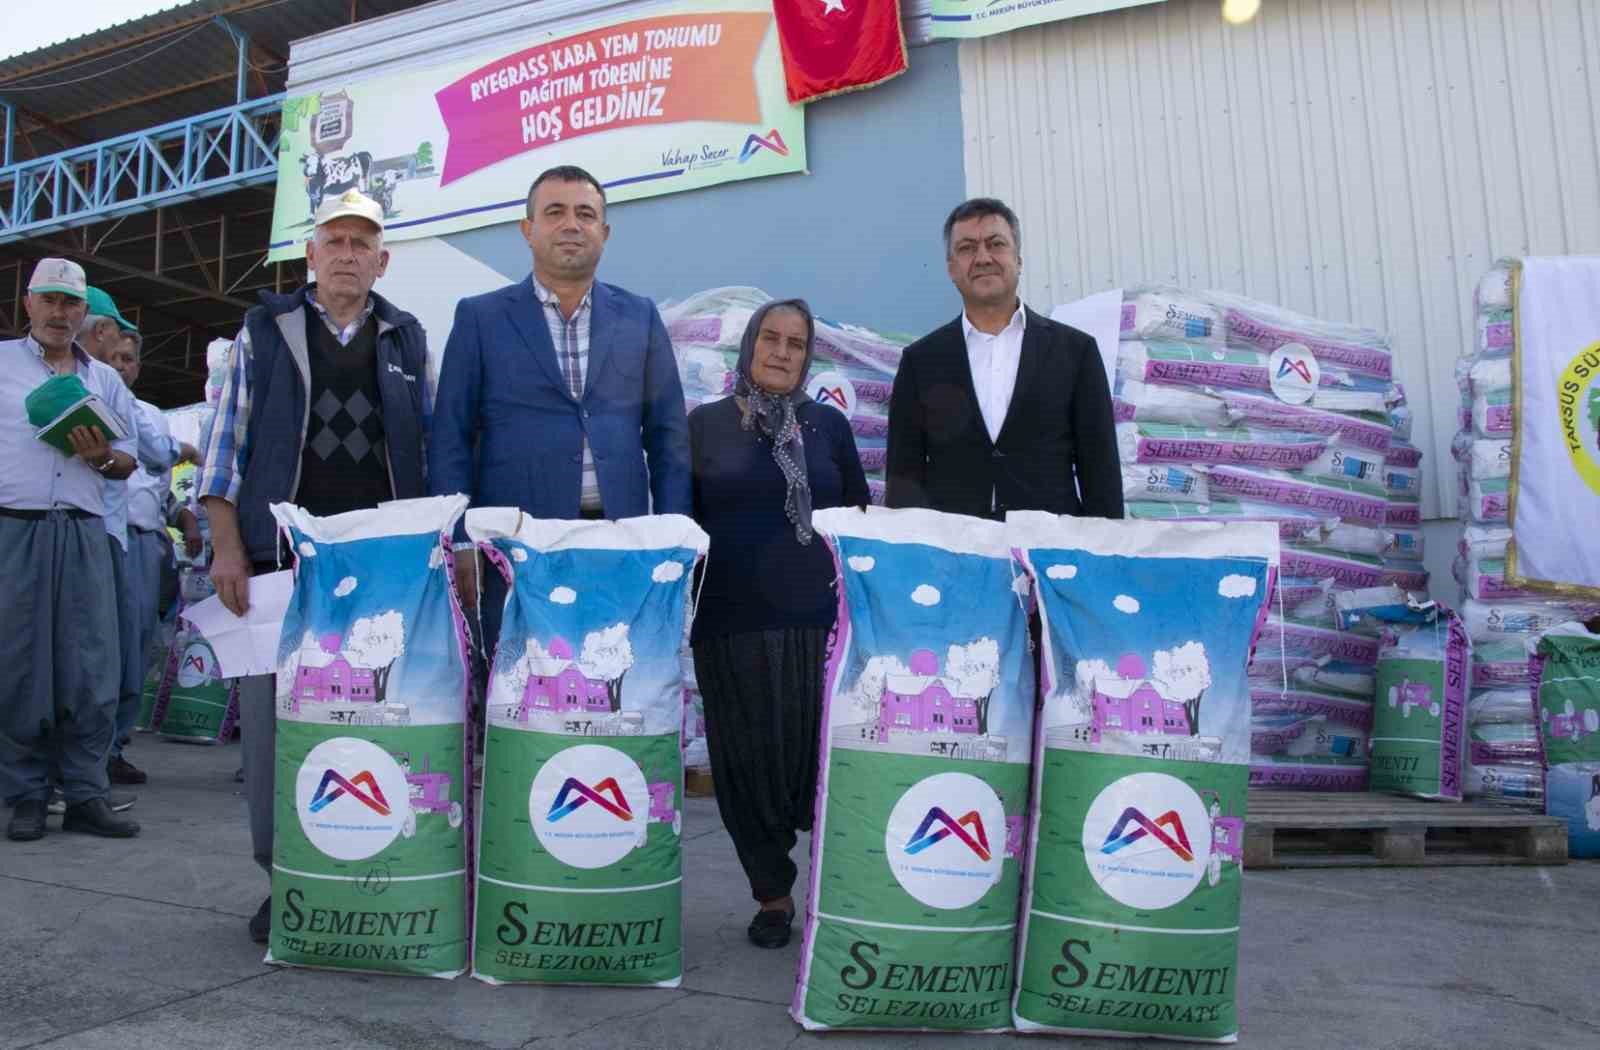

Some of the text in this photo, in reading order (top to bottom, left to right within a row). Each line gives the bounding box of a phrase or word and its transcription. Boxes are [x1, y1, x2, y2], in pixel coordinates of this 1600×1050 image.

[470, 23, 722, 102] RYEGRASS KABA YEM TOHUMU
[519, 56, 673, 110] DAĞITIM TÖRENİ'NE
[520, 82, 666, 144] HOŞ GELDİNİZ
[661, 148, 698, 171] Vahap
[1559, 346, 1600, 454] TARSUS SÜ
[281, 887, 439, 936] SEMENTI
[496, 901, 664, 947] SEMENTI
[280, 936, 431, 961] SELEZIONATE
[495, 951, 658, 971] SELEZIONATE
[840, 940, 1009, 993] SEMENTI
[1050, 938, 1230, 995] SEMENTI
[836, 993, 1001, 1020] SELEZIONATE
[1047, 992, 1221, 1024] SELEZIONATE
